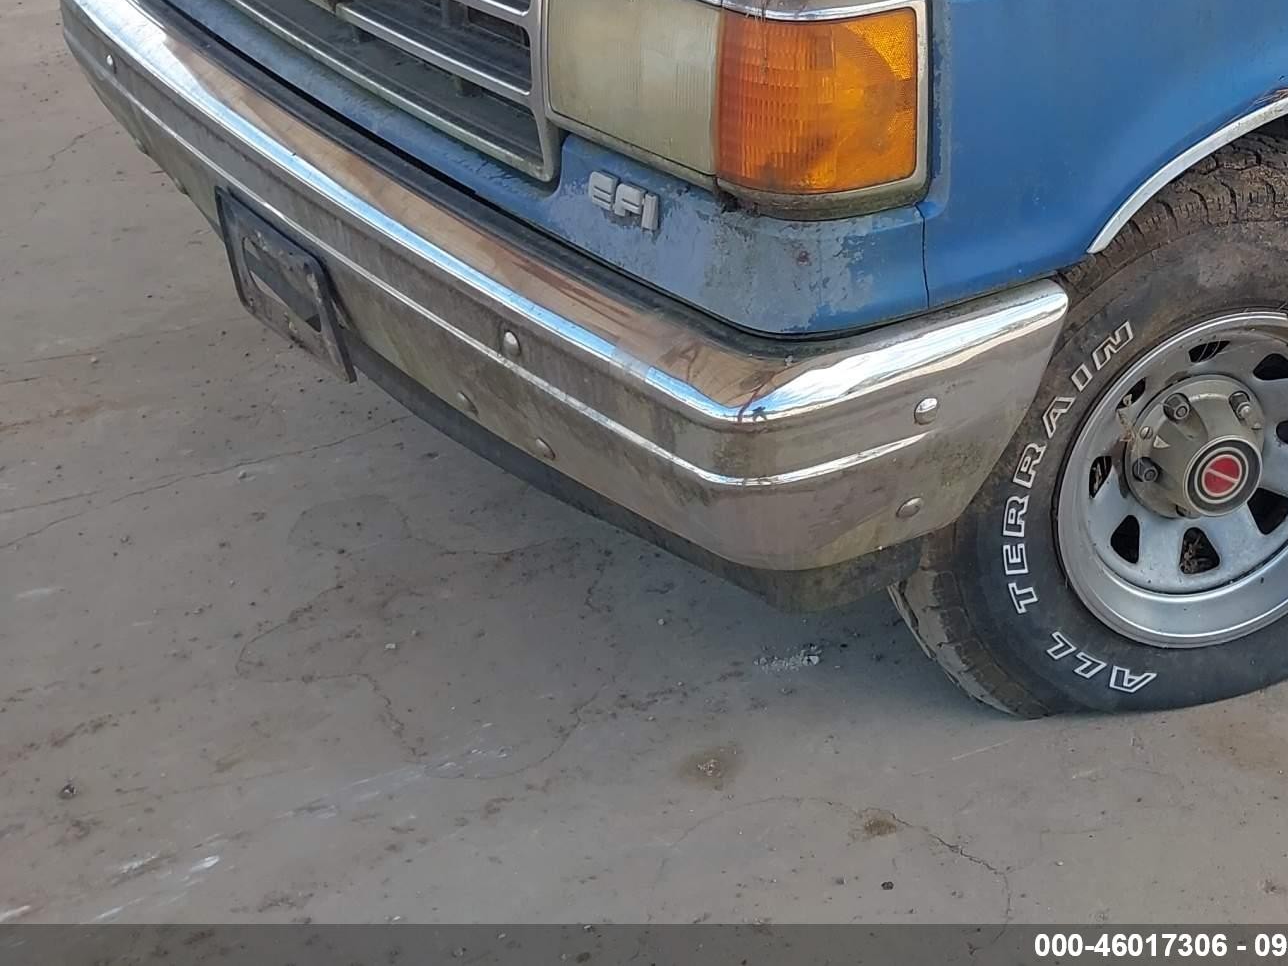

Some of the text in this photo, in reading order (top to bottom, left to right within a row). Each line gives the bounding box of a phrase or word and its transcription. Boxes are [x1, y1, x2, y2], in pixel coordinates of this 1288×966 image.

[587, 171, 659, 231] EFI
[1003, 321, 1157, 693] ALL TERRAIN
